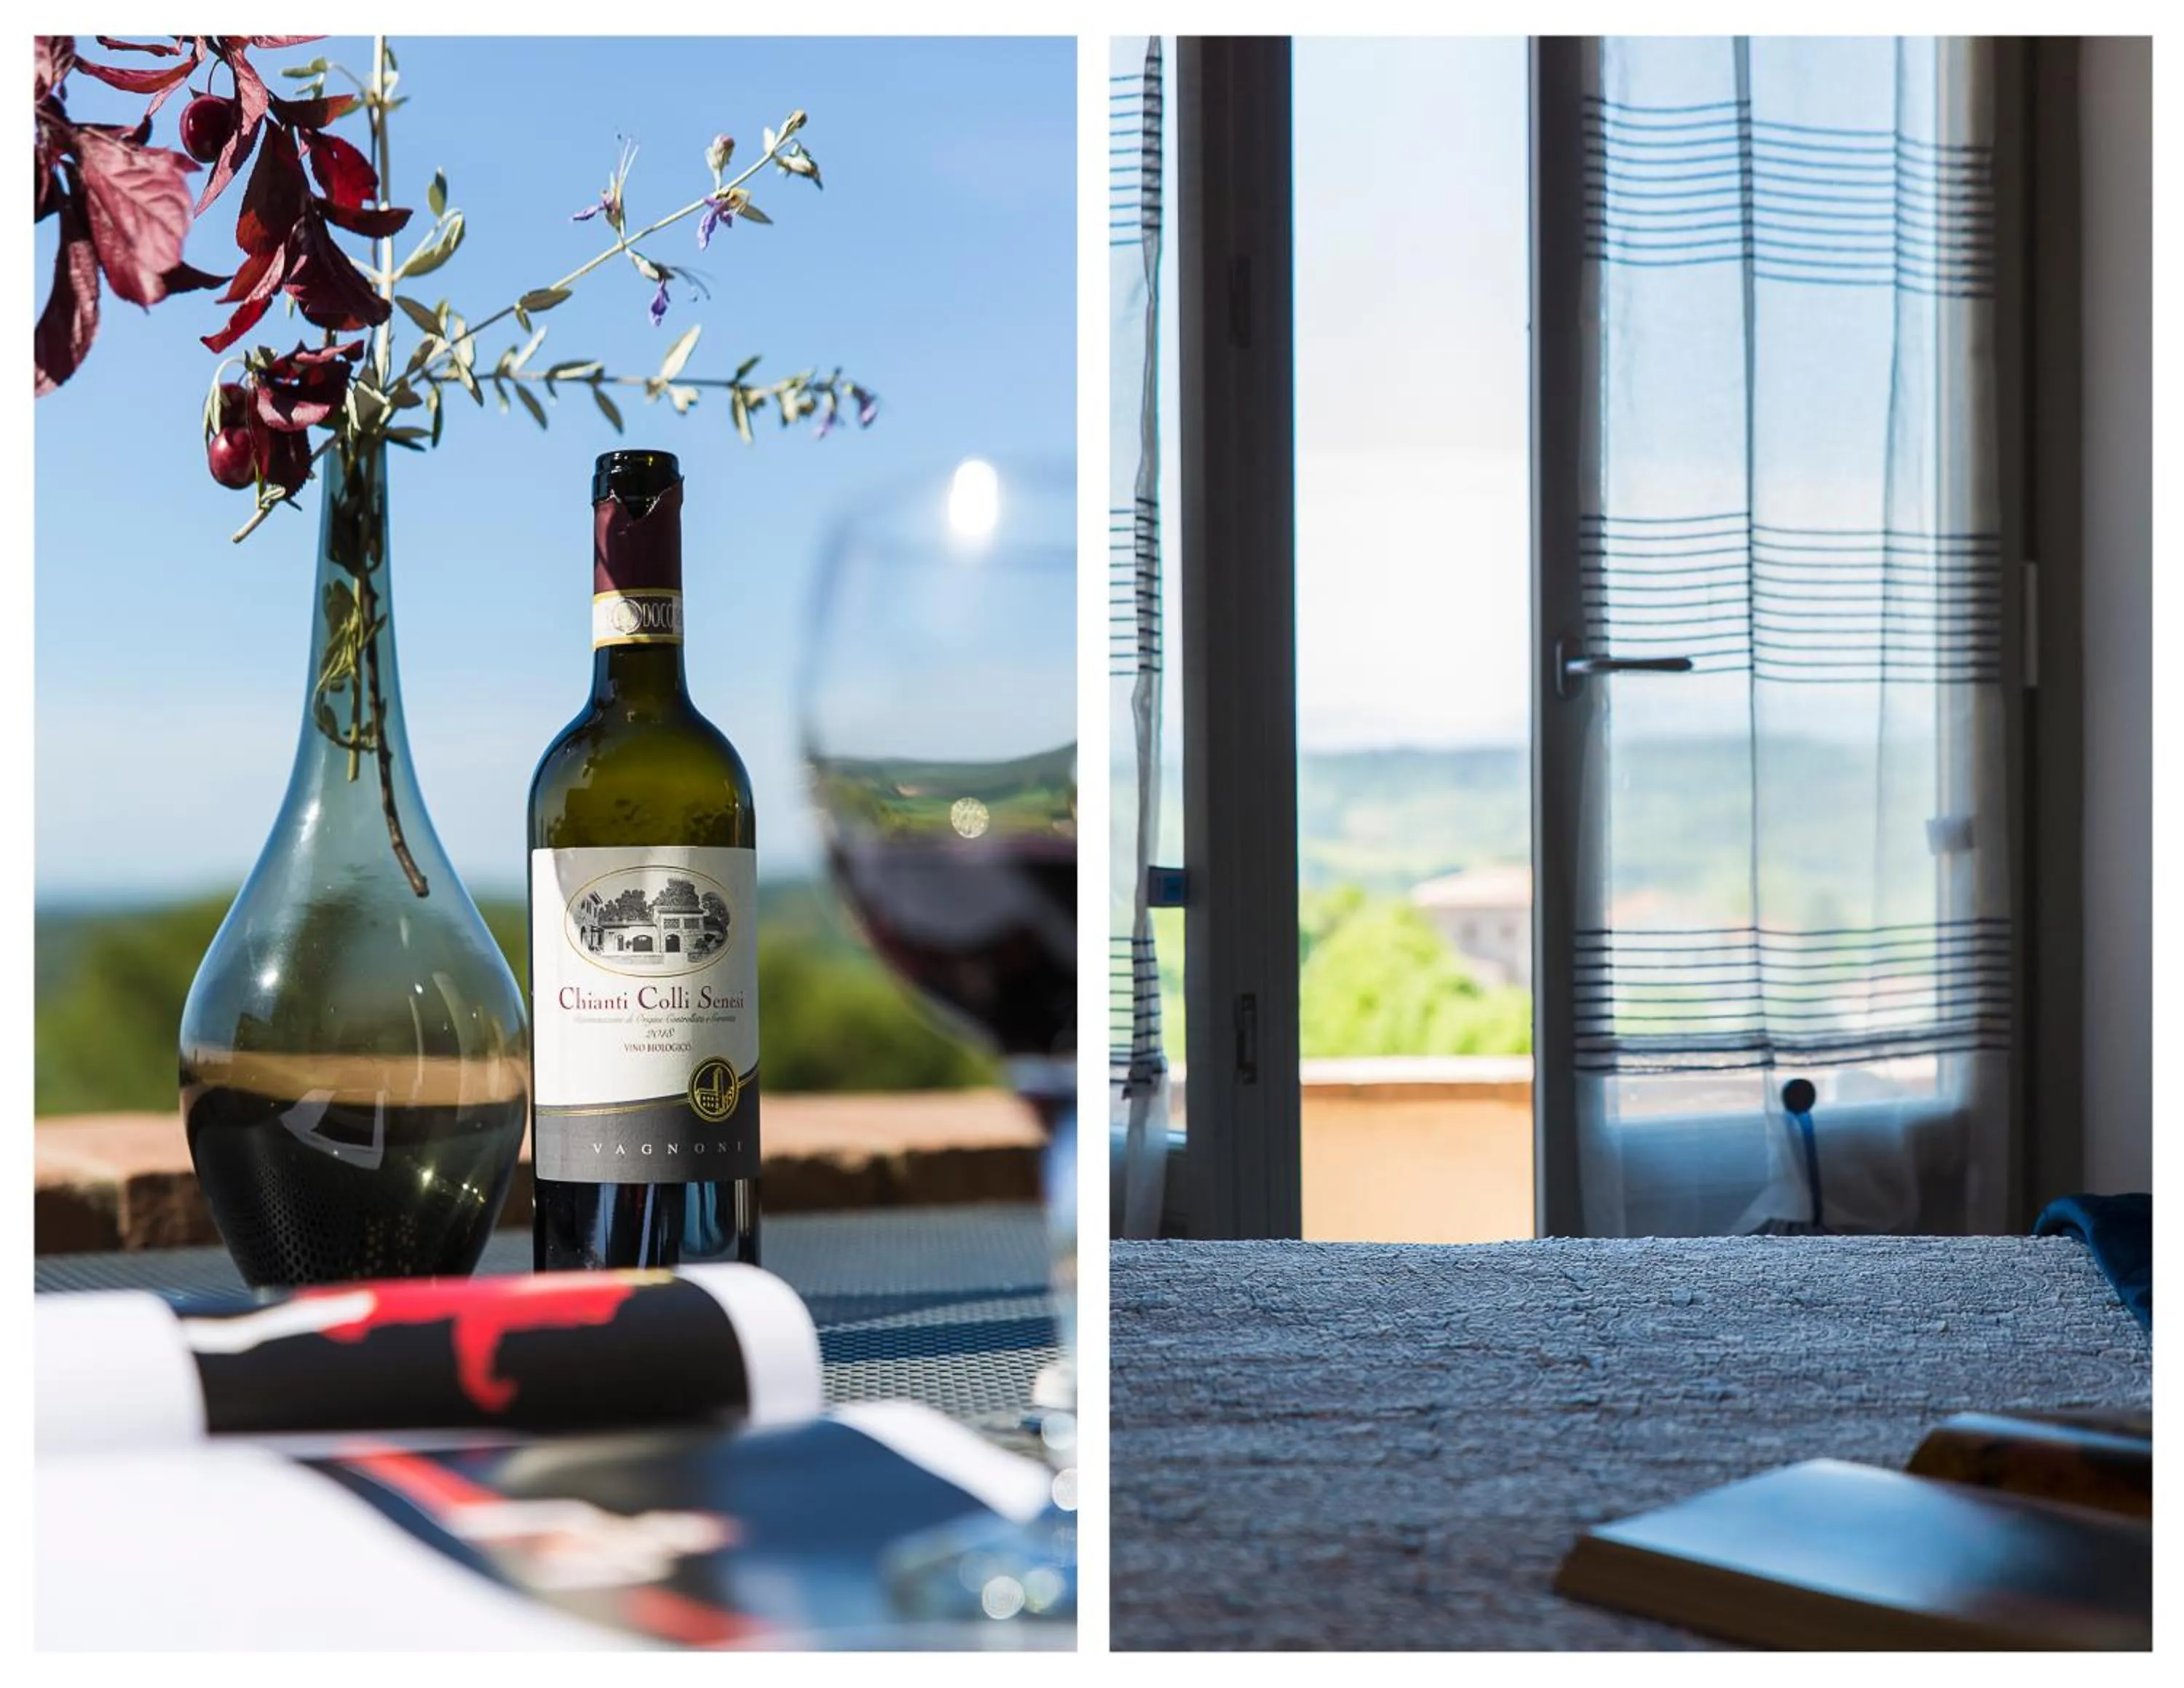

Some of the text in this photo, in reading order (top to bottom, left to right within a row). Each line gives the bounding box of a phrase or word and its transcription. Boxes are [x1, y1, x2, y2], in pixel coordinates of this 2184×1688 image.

[558, 985, 744, 1009] Chianti Colli Senesi
[624, 1043, 646, 1052] VINO
[593, 1141, 742, 1156] VAGNONI
